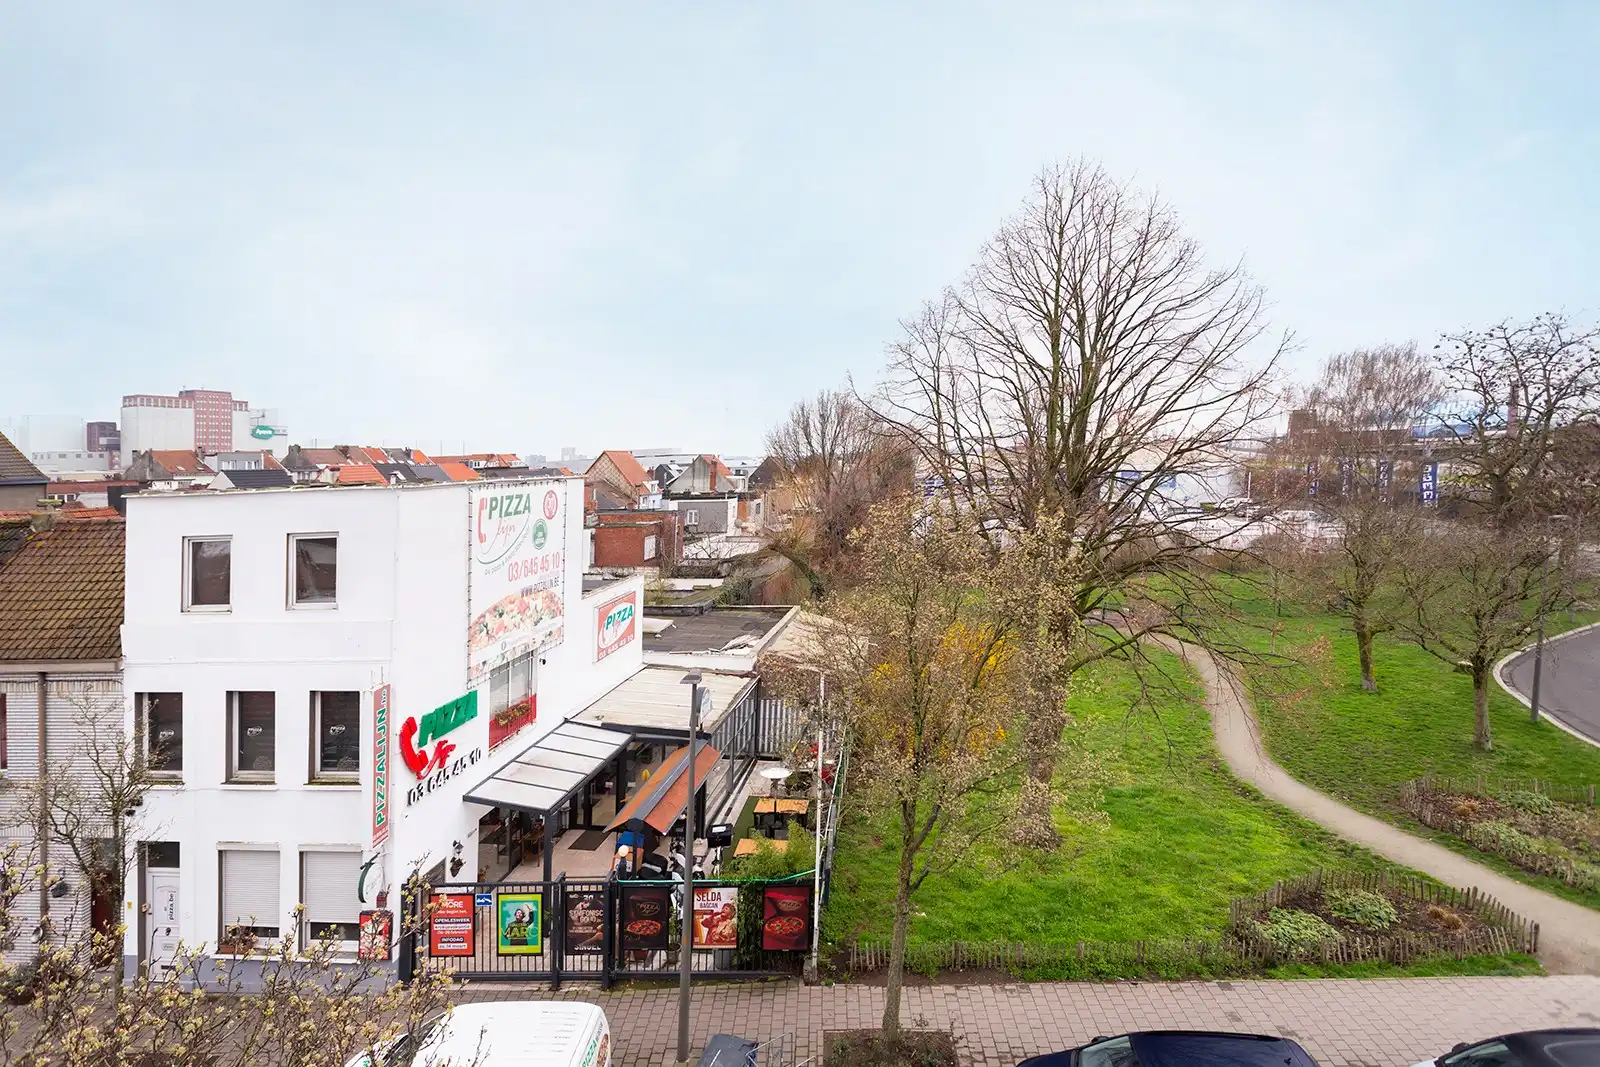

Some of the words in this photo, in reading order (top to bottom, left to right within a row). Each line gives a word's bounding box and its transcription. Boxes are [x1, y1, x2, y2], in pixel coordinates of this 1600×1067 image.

[488, 493, 531, 520] PIZZA
[508, 556, 538, 582] 03/645
[540, 554, 549, 573] 45
[552, 552, 560, 570] 10
[605, 605, 634, 630] PIZZA
[418, 689, 478, 748] PIZZA
[406, 783, 424, 807] 03
[427, 766, 450, 793] 645
[452, 757, 467, 777] 45
[469, 747, 482, 766] 10
[696, 892, 722, 902] SELDA
[569, 909, 604, 917] SYMFONISC
